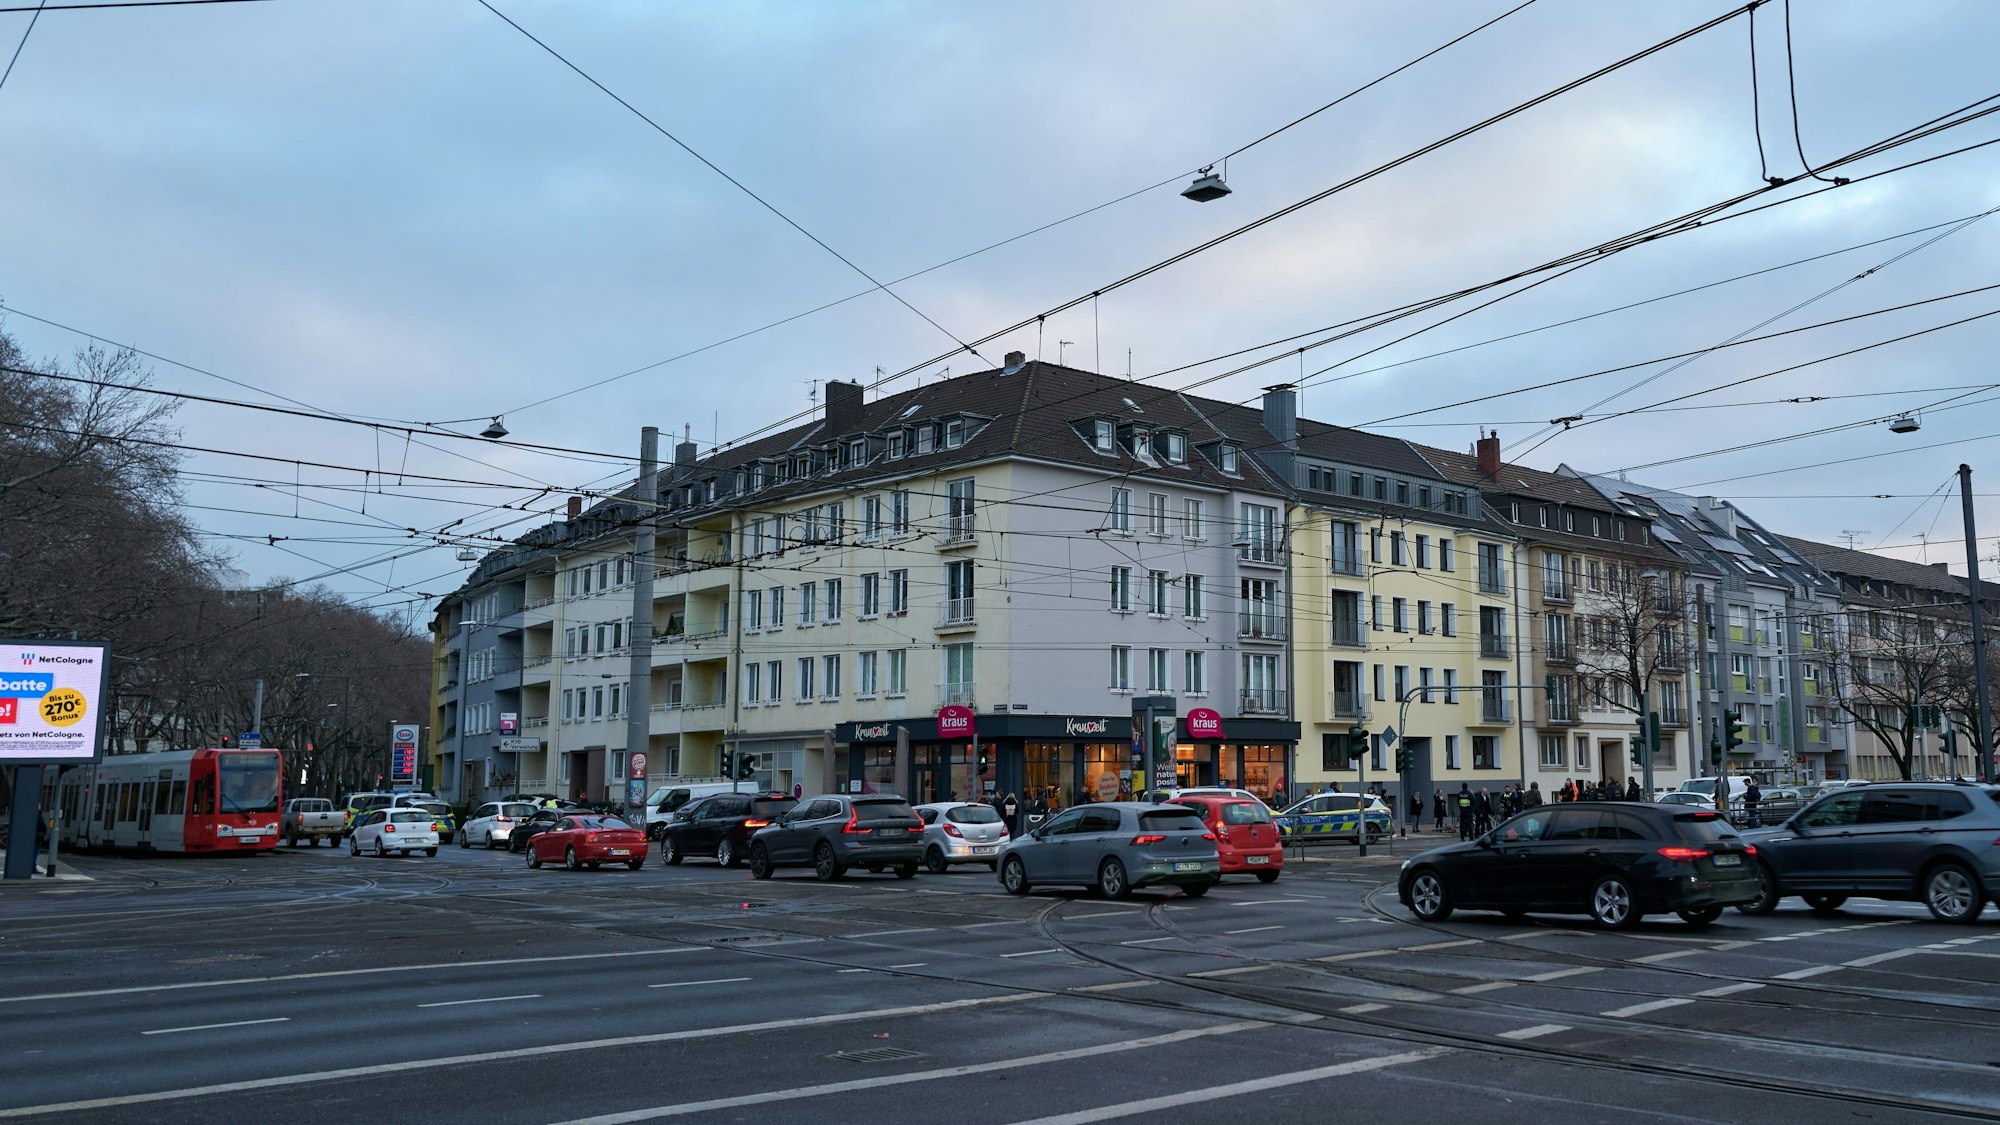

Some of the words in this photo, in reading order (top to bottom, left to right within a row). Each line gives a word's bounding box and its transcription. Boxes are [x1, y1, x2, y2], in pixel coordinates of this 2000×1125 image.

[39, 656, 93, 665] NetCologne
[44, 698, 81, 716] 270€
[942, 716, 967, 728] kraus
[1193, 717, 1217, 729] kraus
[32, 731, 85, 739] NetCologne.
